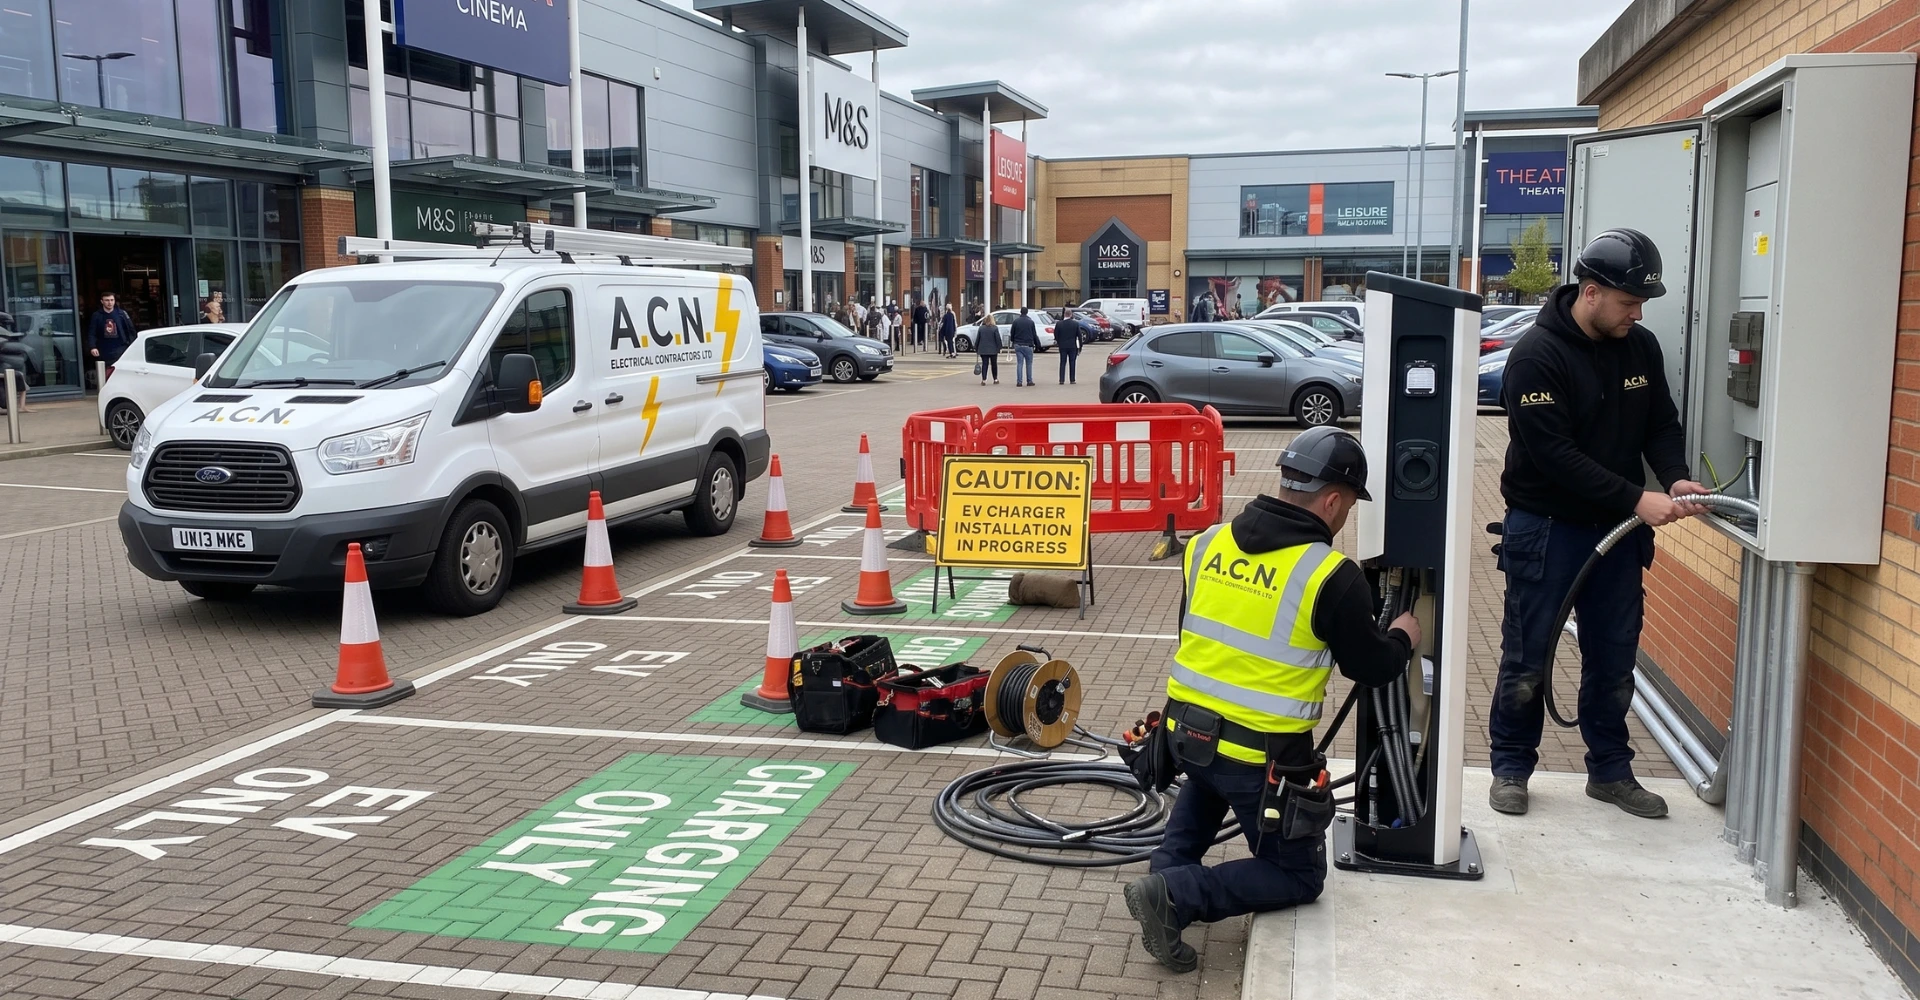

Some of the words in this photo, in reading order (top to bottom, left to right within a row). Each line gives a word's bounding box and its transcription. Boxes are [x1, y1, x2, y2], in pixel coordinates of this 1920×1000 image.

[456, 0, 528, 32] CINEMA
[824, 92, 869, 150] M&S
[997, 155, 1023, 183] LEISURE
[416, 206, 456, 233] M&S
[1337, 206, 1388, 218] LEISURE
[1099, 244, 1130, 257] M&S
[610, 296, 712, 350] A.C.N.
[611, 355, 654, 370] ELECTRICAL
[654, 350, 701, 365] CONTRACTORS
[701, 349, 713, 360] LTD
[190, 406, 296, 425] A.C.N.
[955, 469, 1080, 491] CAUTION:
[962, 505, 982, 517] EV
[987, 505, 1066, 519] CHARGER
[216, 531, 246, 548] MKE
[954, 522, 1072, 537] INSTALLATION
[957, 539, 974, 552] IN
[979, 539, 1067, 554] PROGRESS
[667, 571, 763, 599] ONLY
[1203, 552, 1278, 592] A.C.N.
[469, 641, 608, 688] ONLY
[590, 650, 692, 678] EV
[78, 767, 330, 861] ONLY
[270, 785, 438, 841] EV
[474, 789, 672, 886] ONLY
[557, 764, 827, 936] CHARGING
